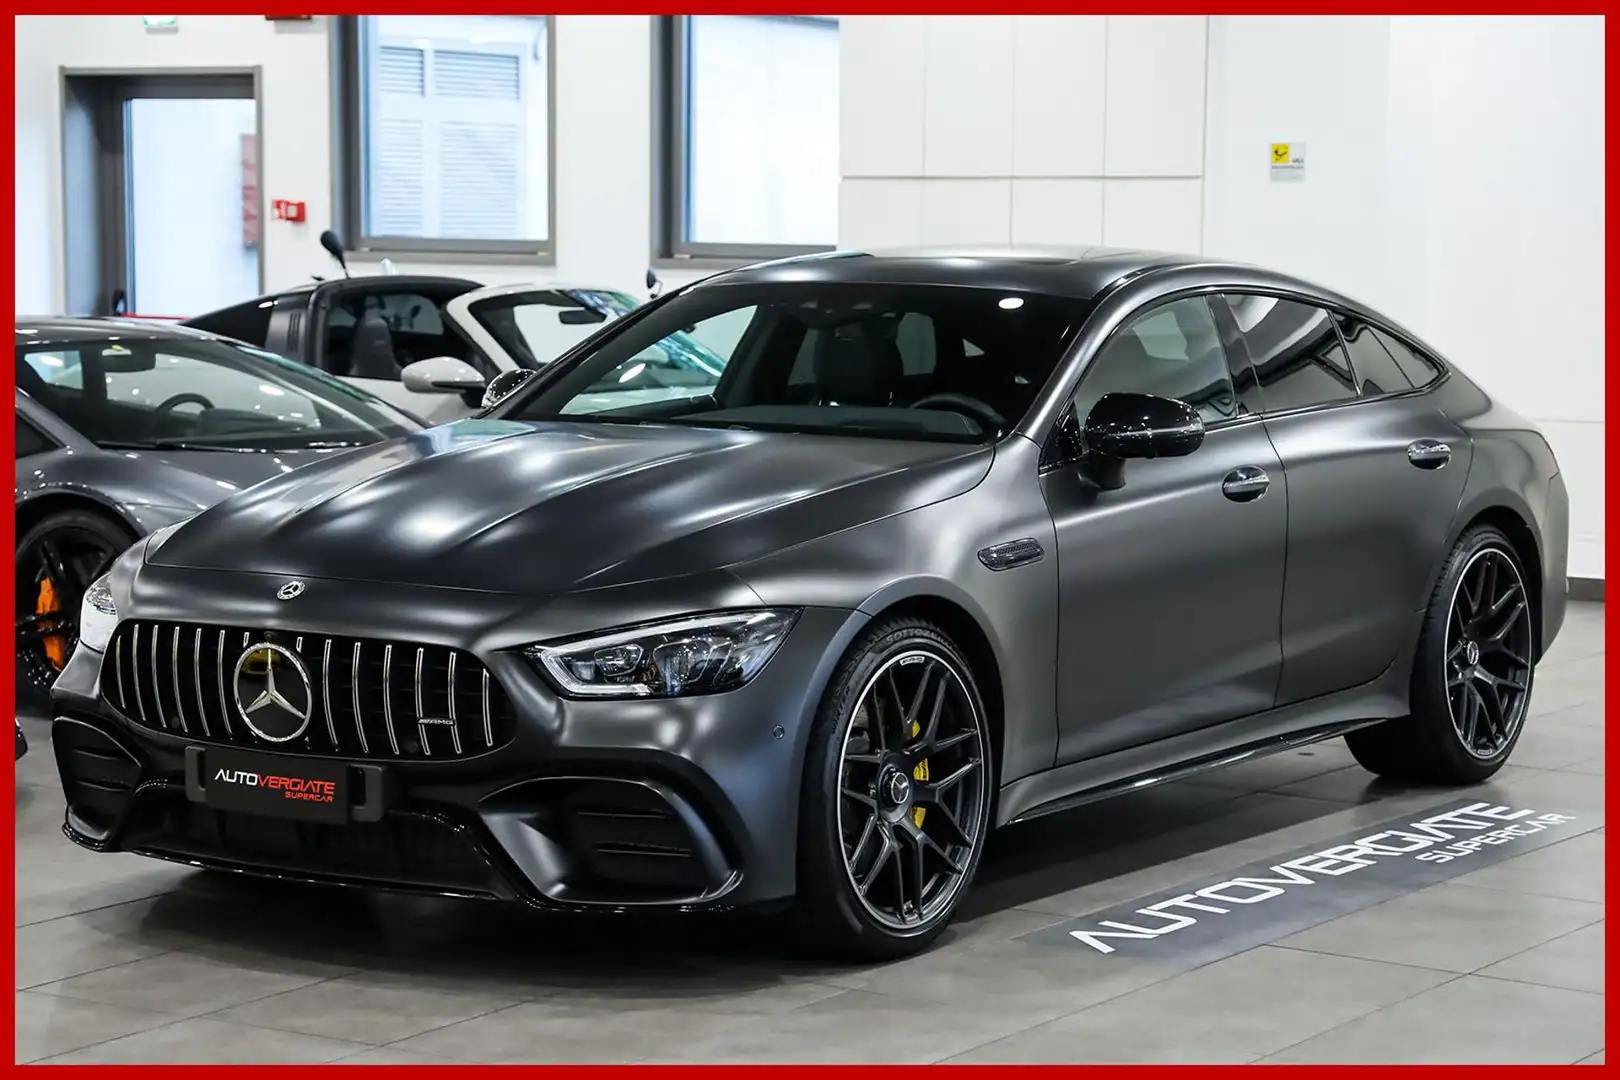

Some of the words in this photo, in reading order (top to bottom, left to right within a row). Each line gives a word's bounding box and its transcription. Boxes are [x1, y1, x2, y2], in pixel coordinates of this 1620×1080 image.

[214, 769, 336, 795] AUTOVERGIATE
[284, 791, 334, 803] SUPERCAR
[1415, 813, 1577, 864] SUPERCAR
[1069, 803, 1536, 954] AUTOVERGIATE
